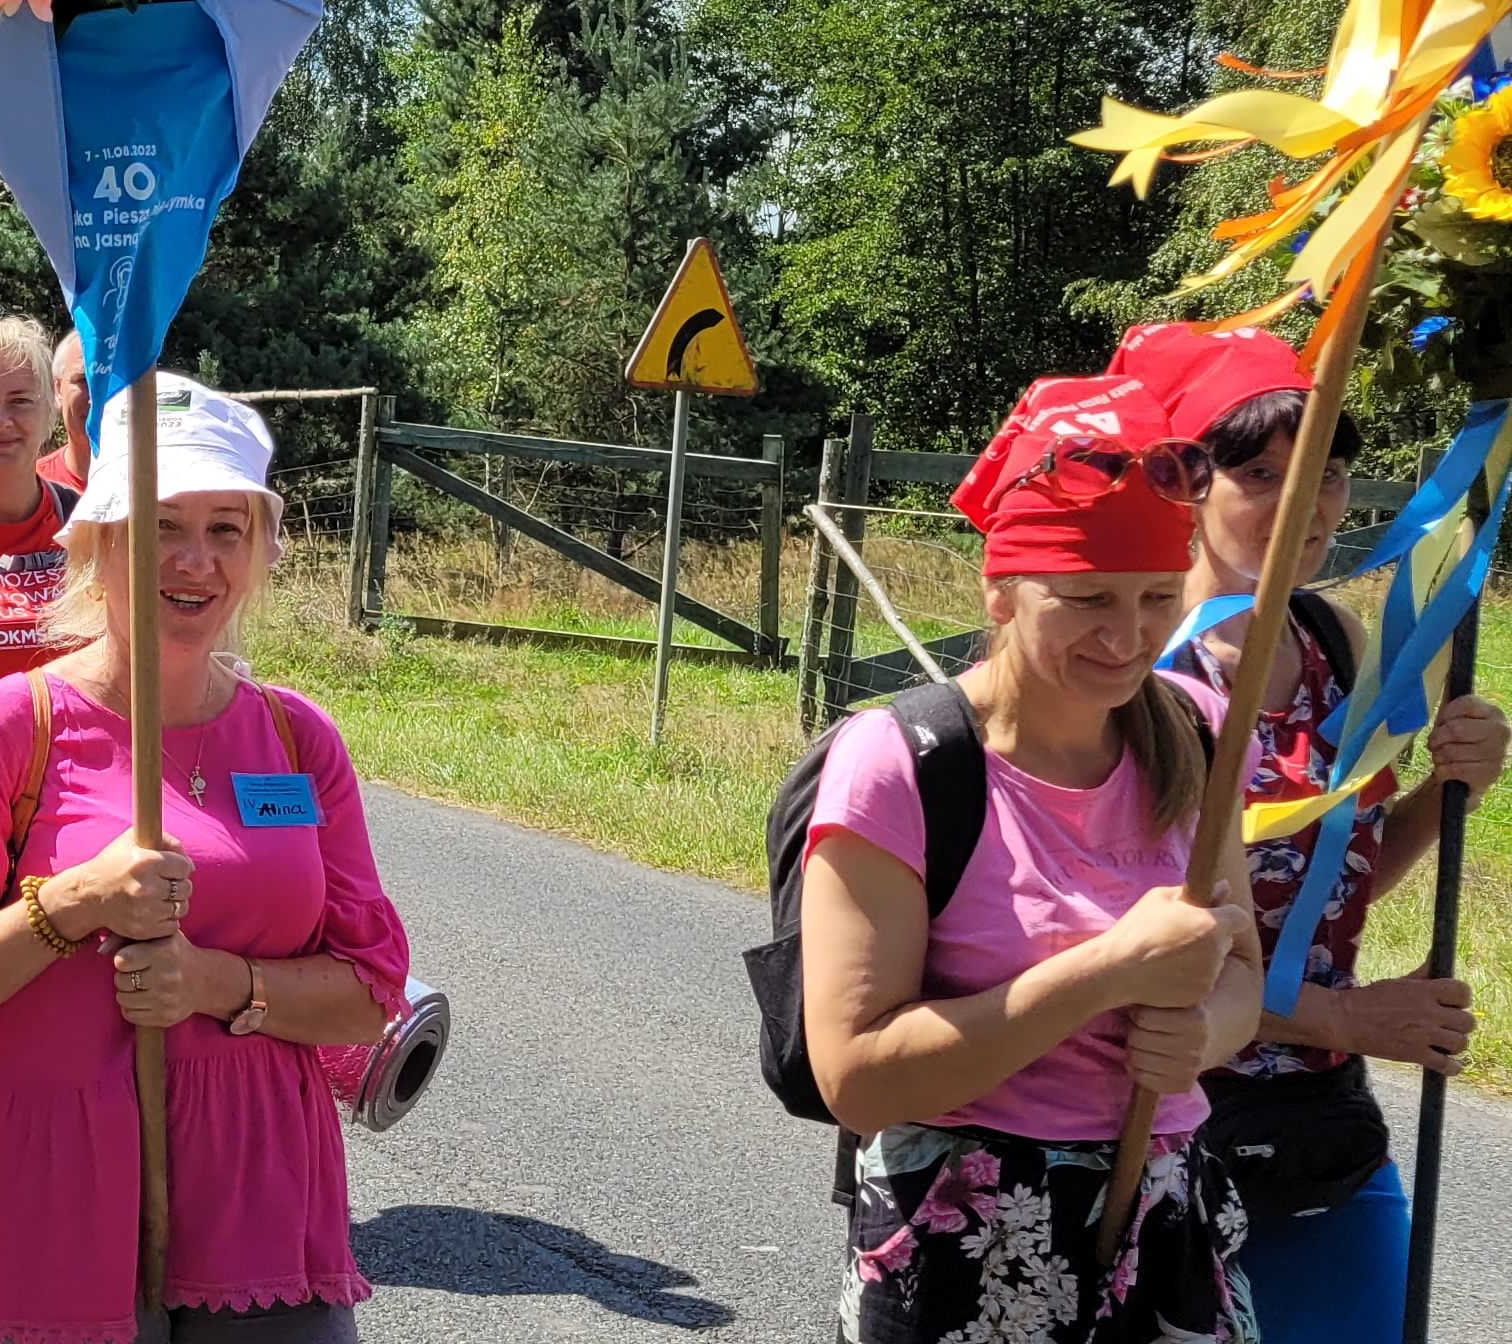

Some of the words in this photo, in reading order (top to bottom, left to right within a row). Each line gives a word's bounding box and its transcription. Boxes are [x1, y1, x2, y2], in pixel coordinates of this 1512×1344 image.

[102, 144, 157, 161] 11.08.2023
[92, 161, 156, 204] 40
[74, 210, 93, 227] ka
